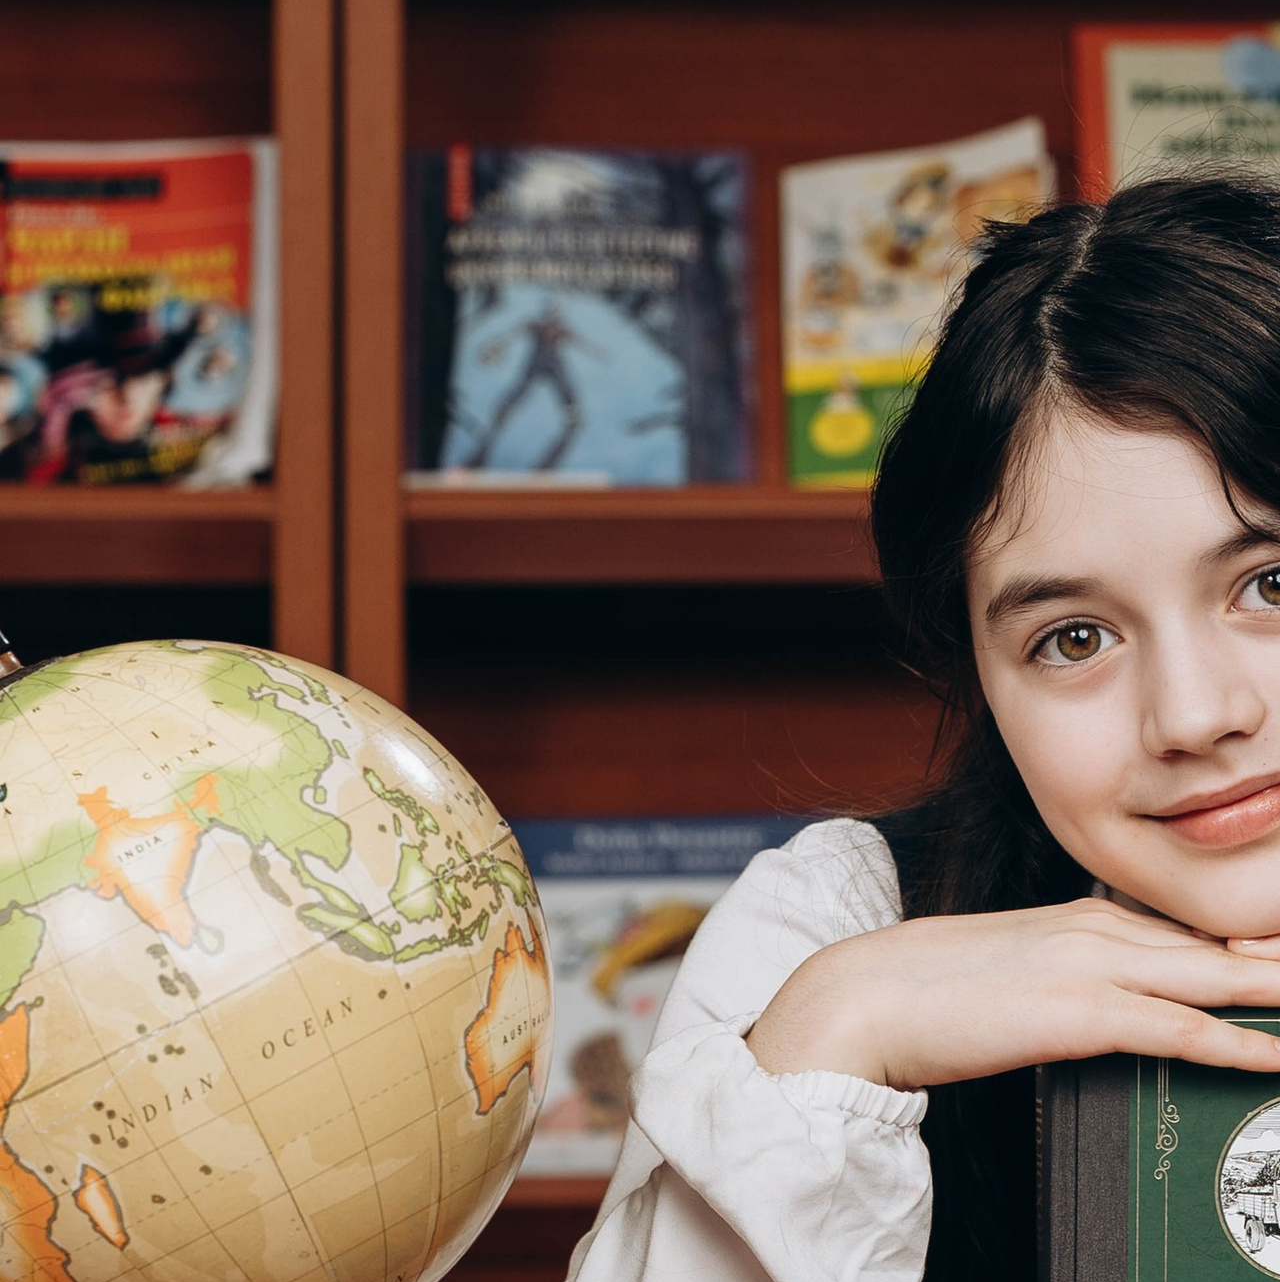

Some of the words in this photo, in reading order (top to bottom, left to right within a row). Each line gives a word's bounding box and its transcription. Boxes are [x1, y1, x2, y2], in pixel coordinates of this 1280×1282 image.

[143, 739, 216, 781] CHINA
[117, 835, 162, 863] INDIA
[107, 1073, 213, 1141] INDIAN
[261, 997, 354, 1060] OCEAN
